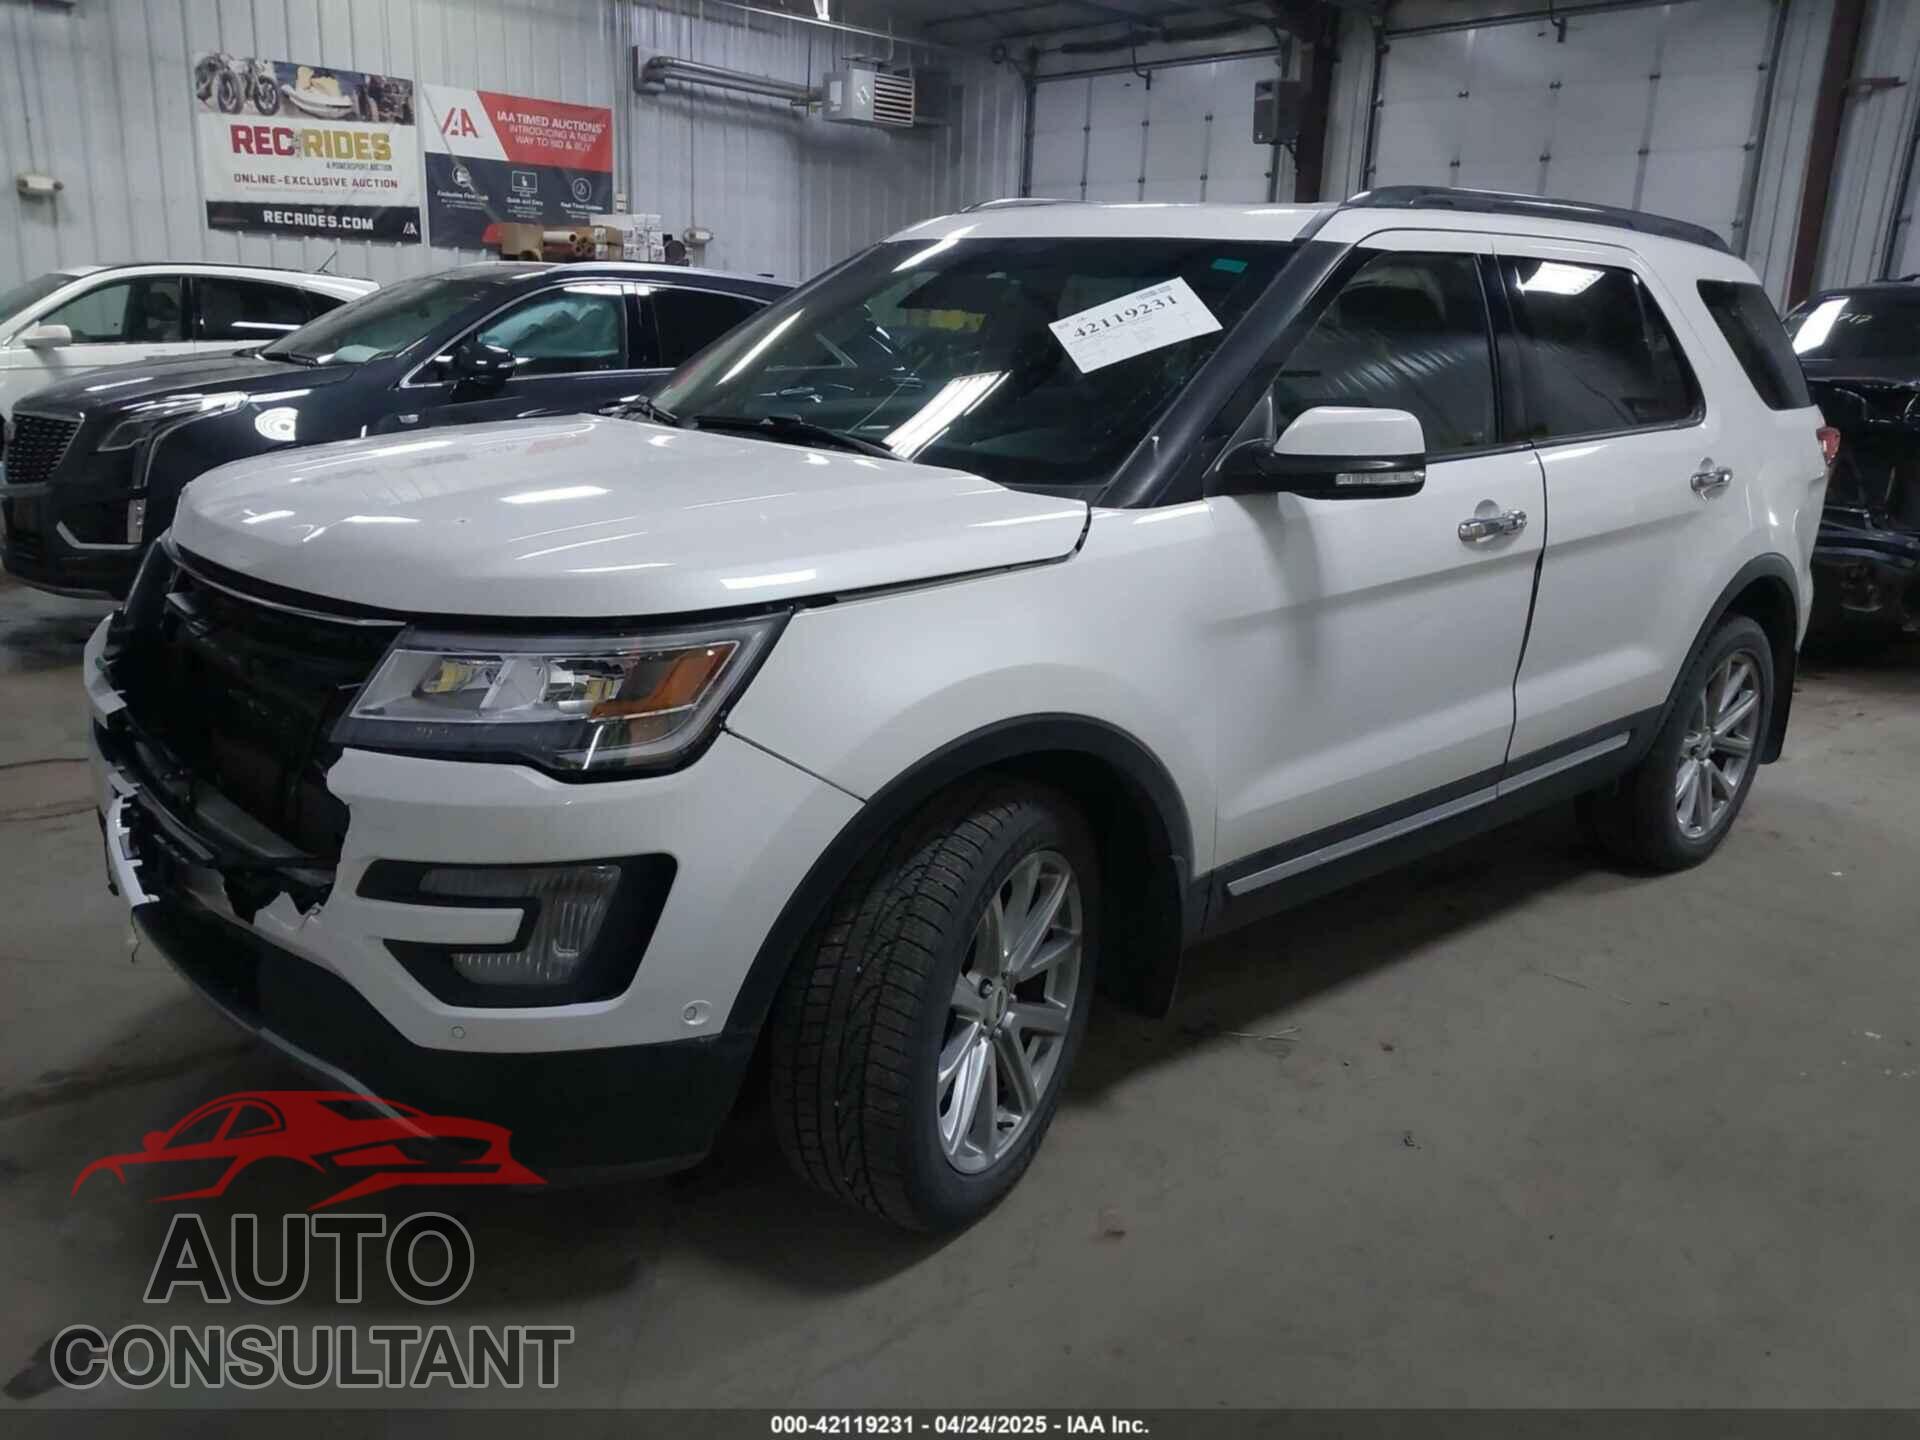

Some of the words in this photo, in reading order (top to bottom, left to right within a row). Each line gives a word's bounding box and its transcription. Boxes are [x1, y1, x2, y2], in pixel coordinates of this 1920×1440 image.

[496, 111, 514, 123] IAA
[516, 113, 549, 127] TIMED
[508, 123, 568, 140] INTRODUCING
[576, 132, 598, 143] NEW
[514, 135, 535, 145] WAY
[536, 136, 549, 146] TO
[233, 173, 348, 187] ONLINE-EXCLUSIVE
[351, 177, 398, 188] AUCTION
[263, 209, 374, 231] RECRIDES.COM
[1073, 295, 1177, 338] 42119231
